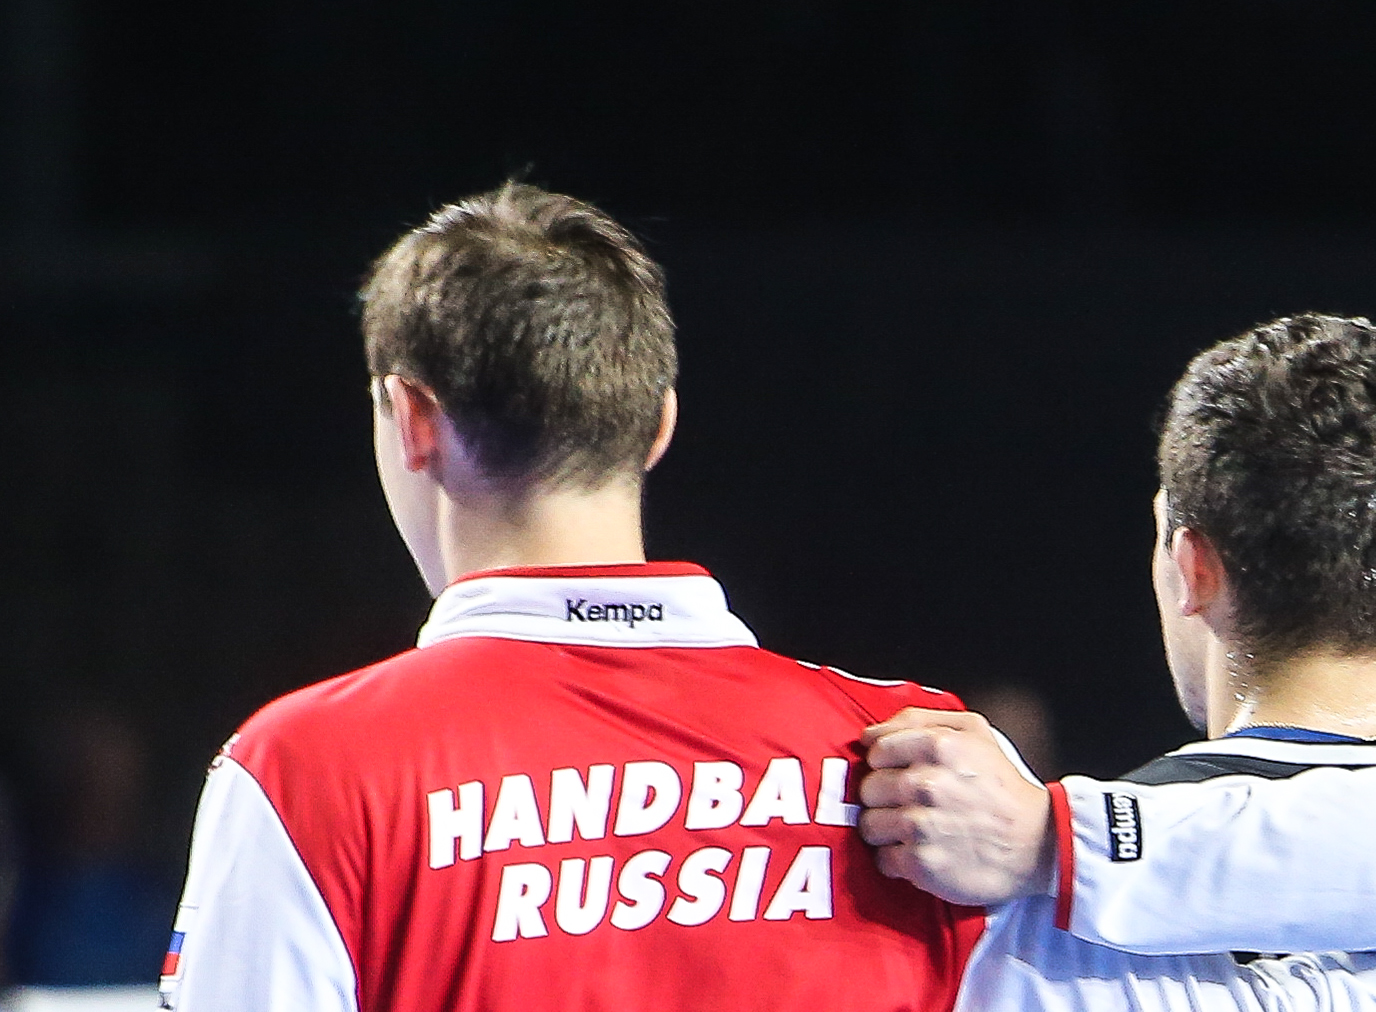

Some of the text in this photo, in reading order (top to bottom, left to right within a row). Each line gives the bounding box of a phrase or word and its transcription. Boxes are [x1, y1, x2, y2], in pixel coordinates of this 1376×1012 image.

[565, 599, 663, 629] Kempa
[426, 756, 859, 870] HANDBAL
[1108, 791, 1139, 860] empa
[490, 845, 835, 943] RUSSIA
